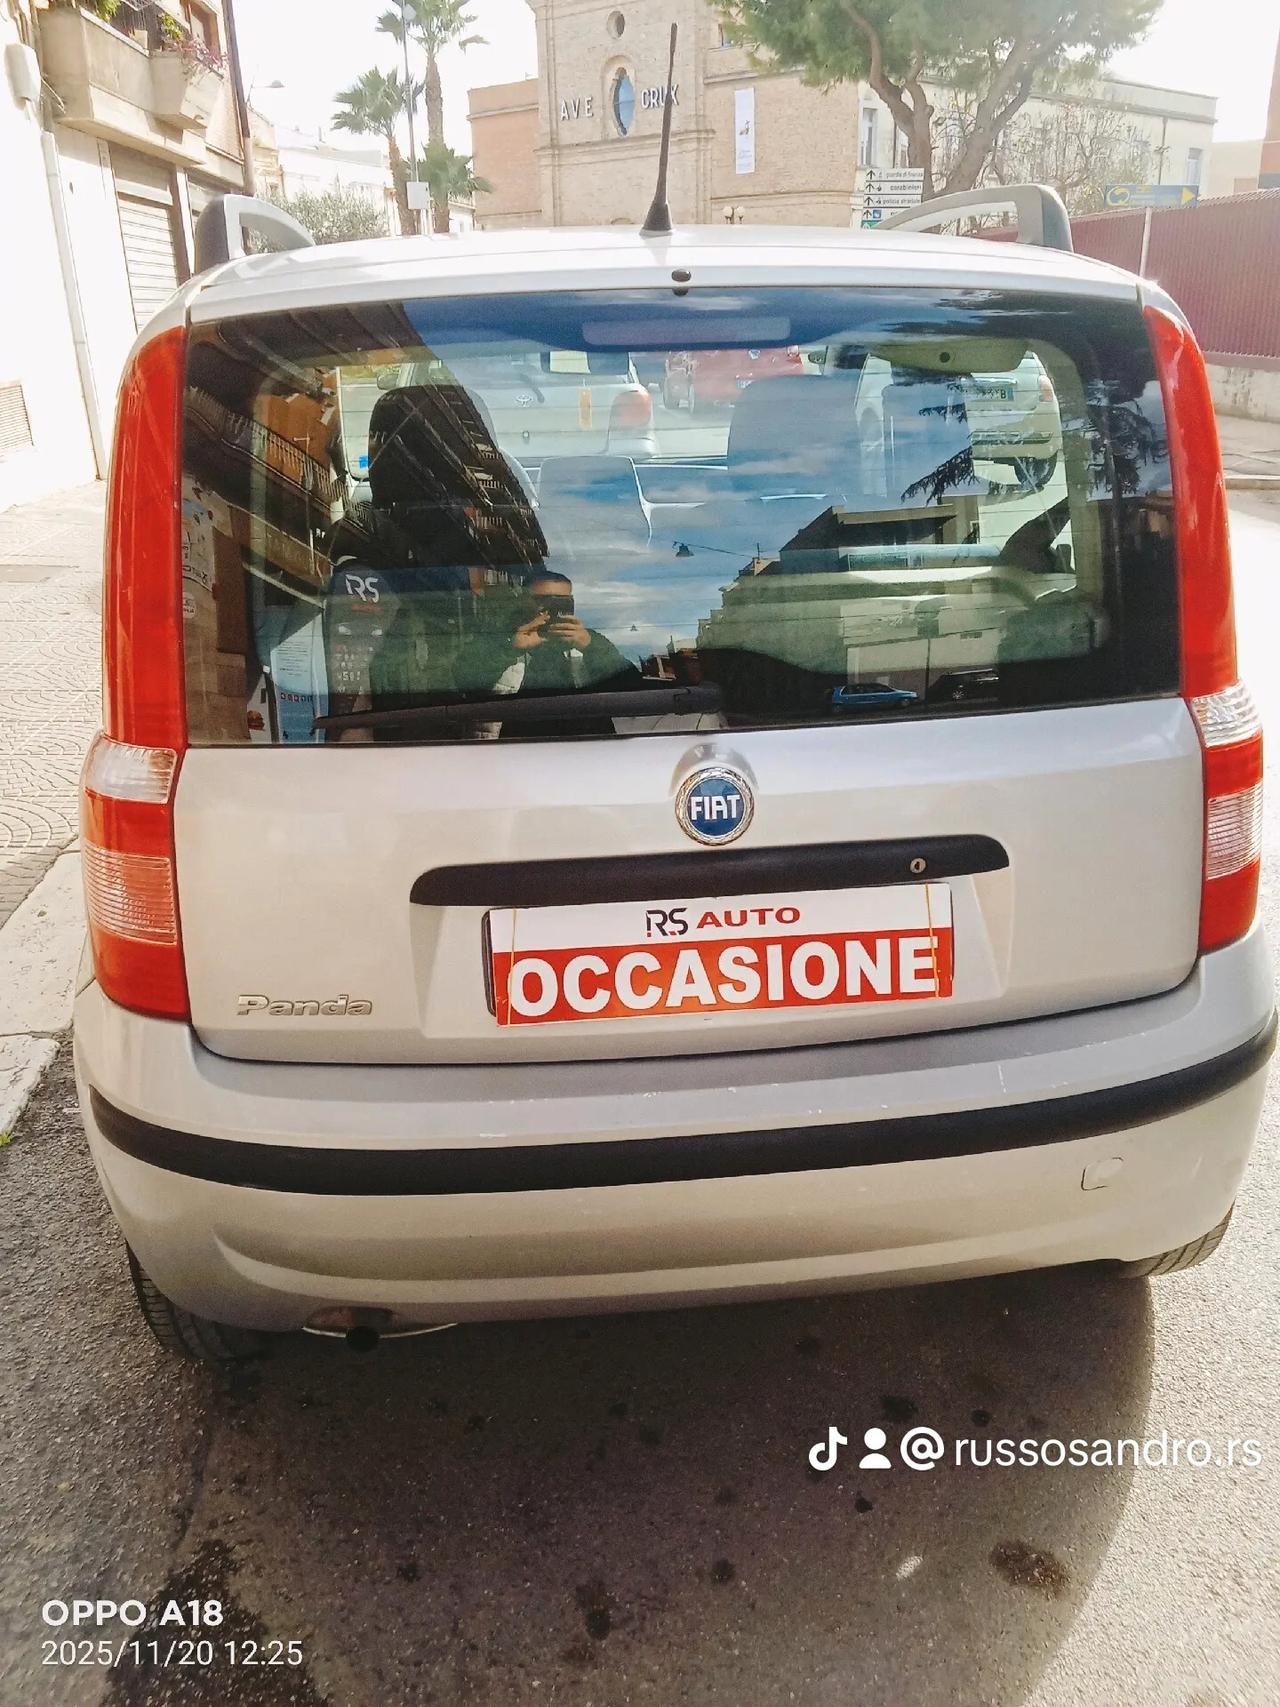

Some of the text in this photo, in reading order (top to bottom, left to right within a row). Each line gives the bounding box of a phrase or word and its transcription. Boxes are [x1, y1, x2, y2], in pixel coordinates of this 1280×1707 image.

[560, 84, 680, 121] AVE CRUX
[690, 794, 741, 821] FIAT
[646, 907, 801, 938] RS AUTO
[507, 935, 940, 1018] OCCASIONE
[237, 993, 373, 1016] Panda
